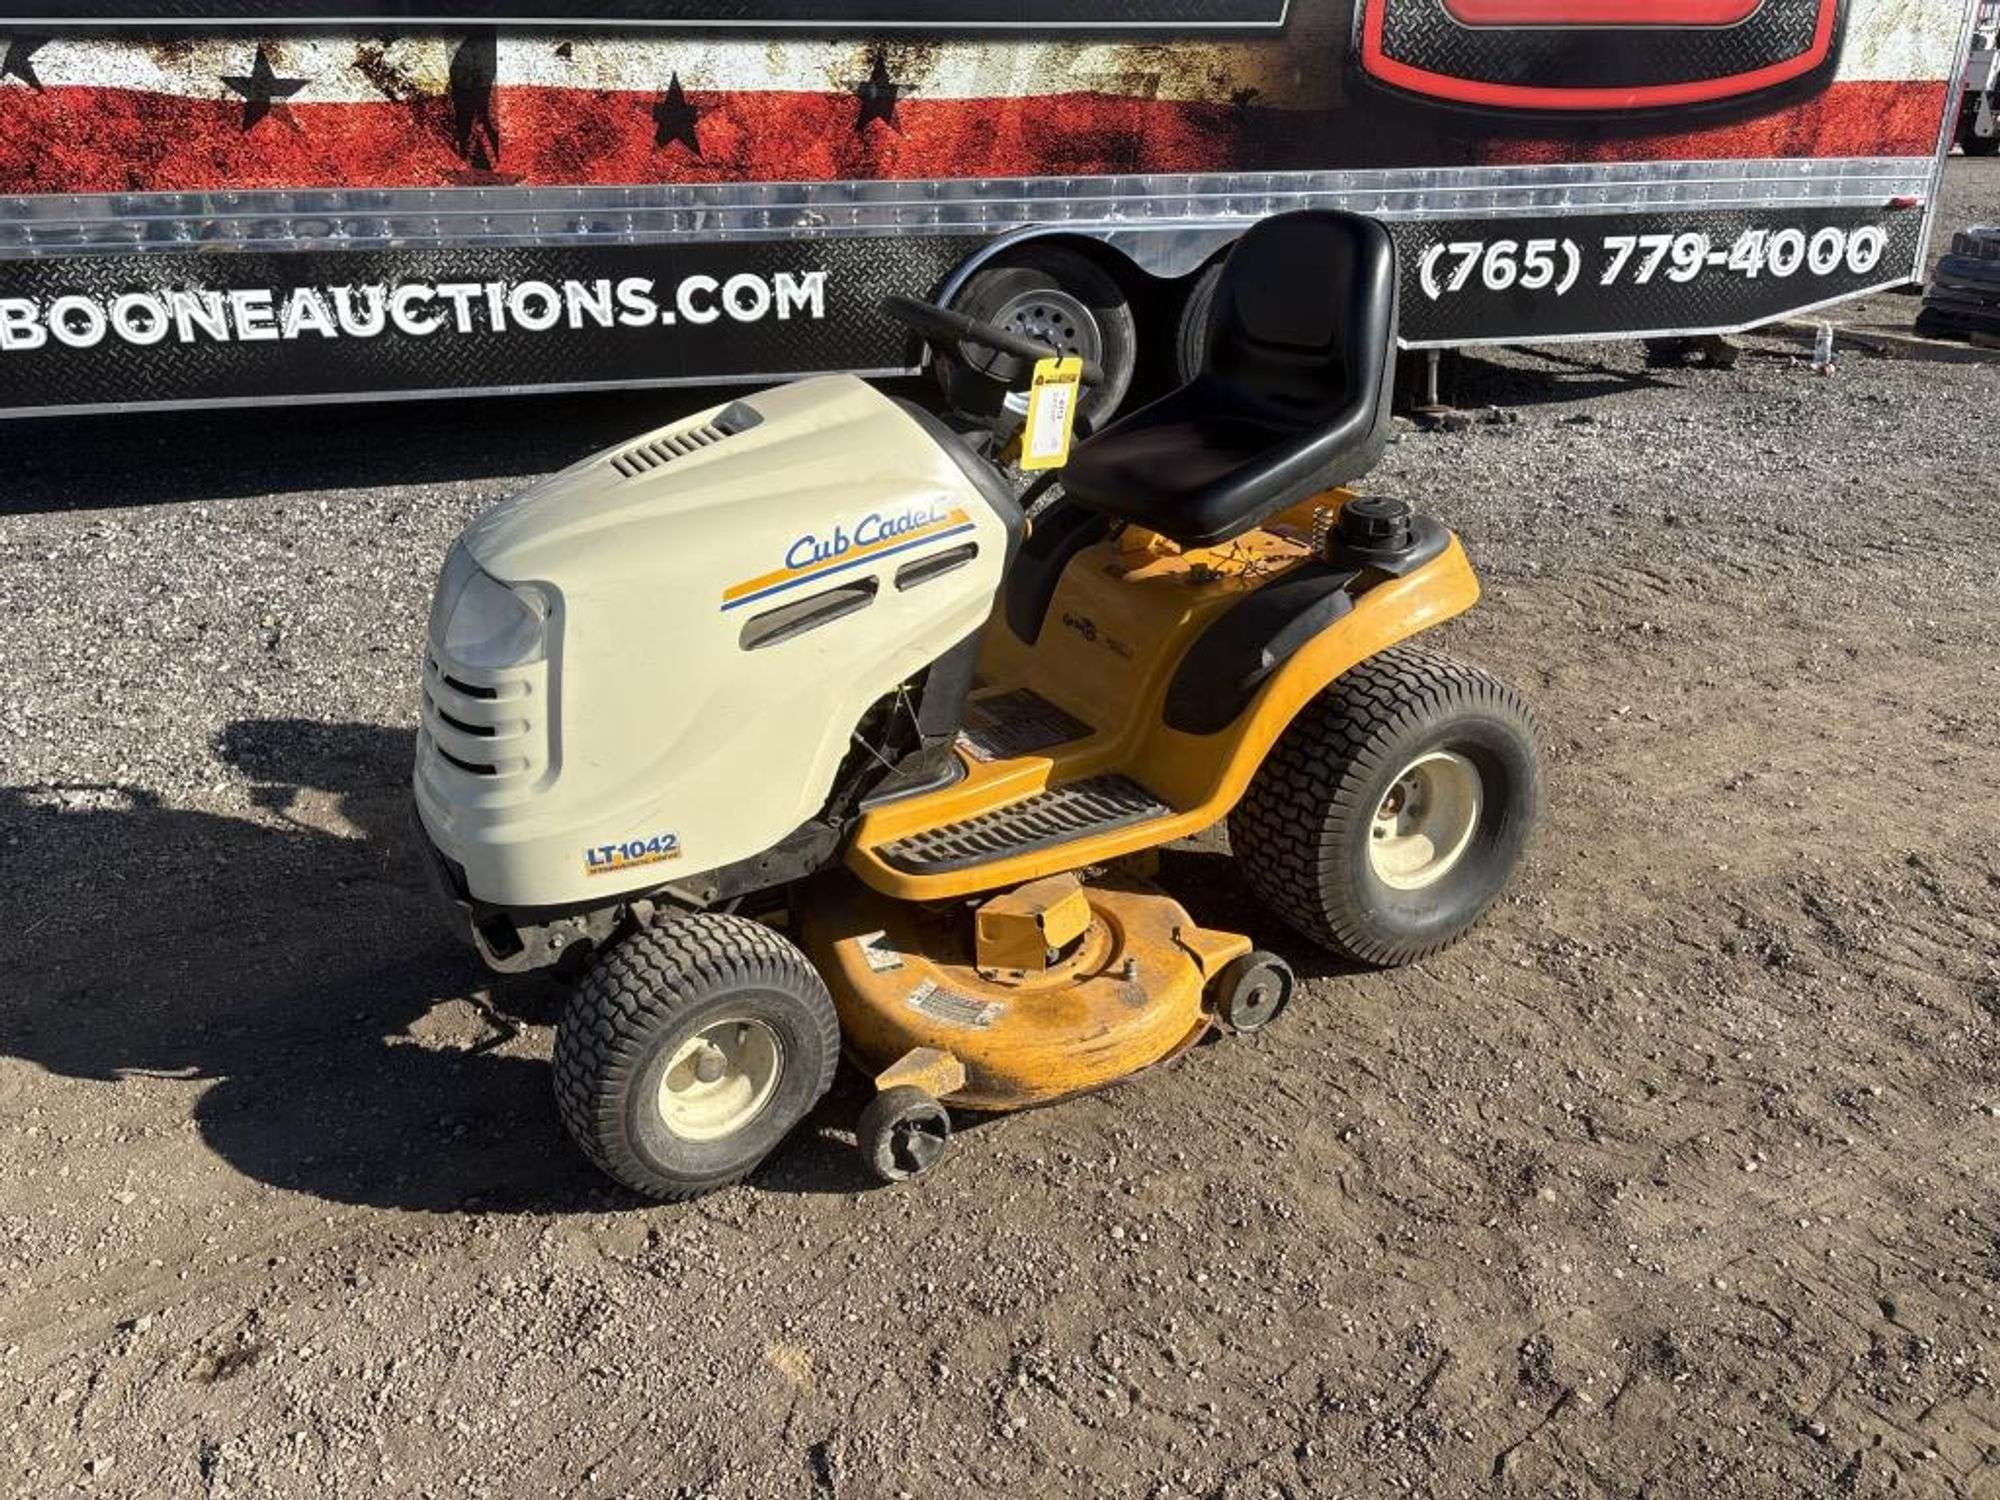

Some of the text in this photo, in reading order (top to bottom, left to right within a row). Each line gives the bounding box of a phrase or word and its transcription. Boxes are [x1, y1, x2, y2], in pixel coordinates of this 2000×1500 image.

[1420, 225, 1888, 300] (765) 779-4000
[0, 271, 827, 351] BOONEAUCTIONS.COM
[785, 526, 849, 569] Cub
[587, 833, 678, 866] LT1042
